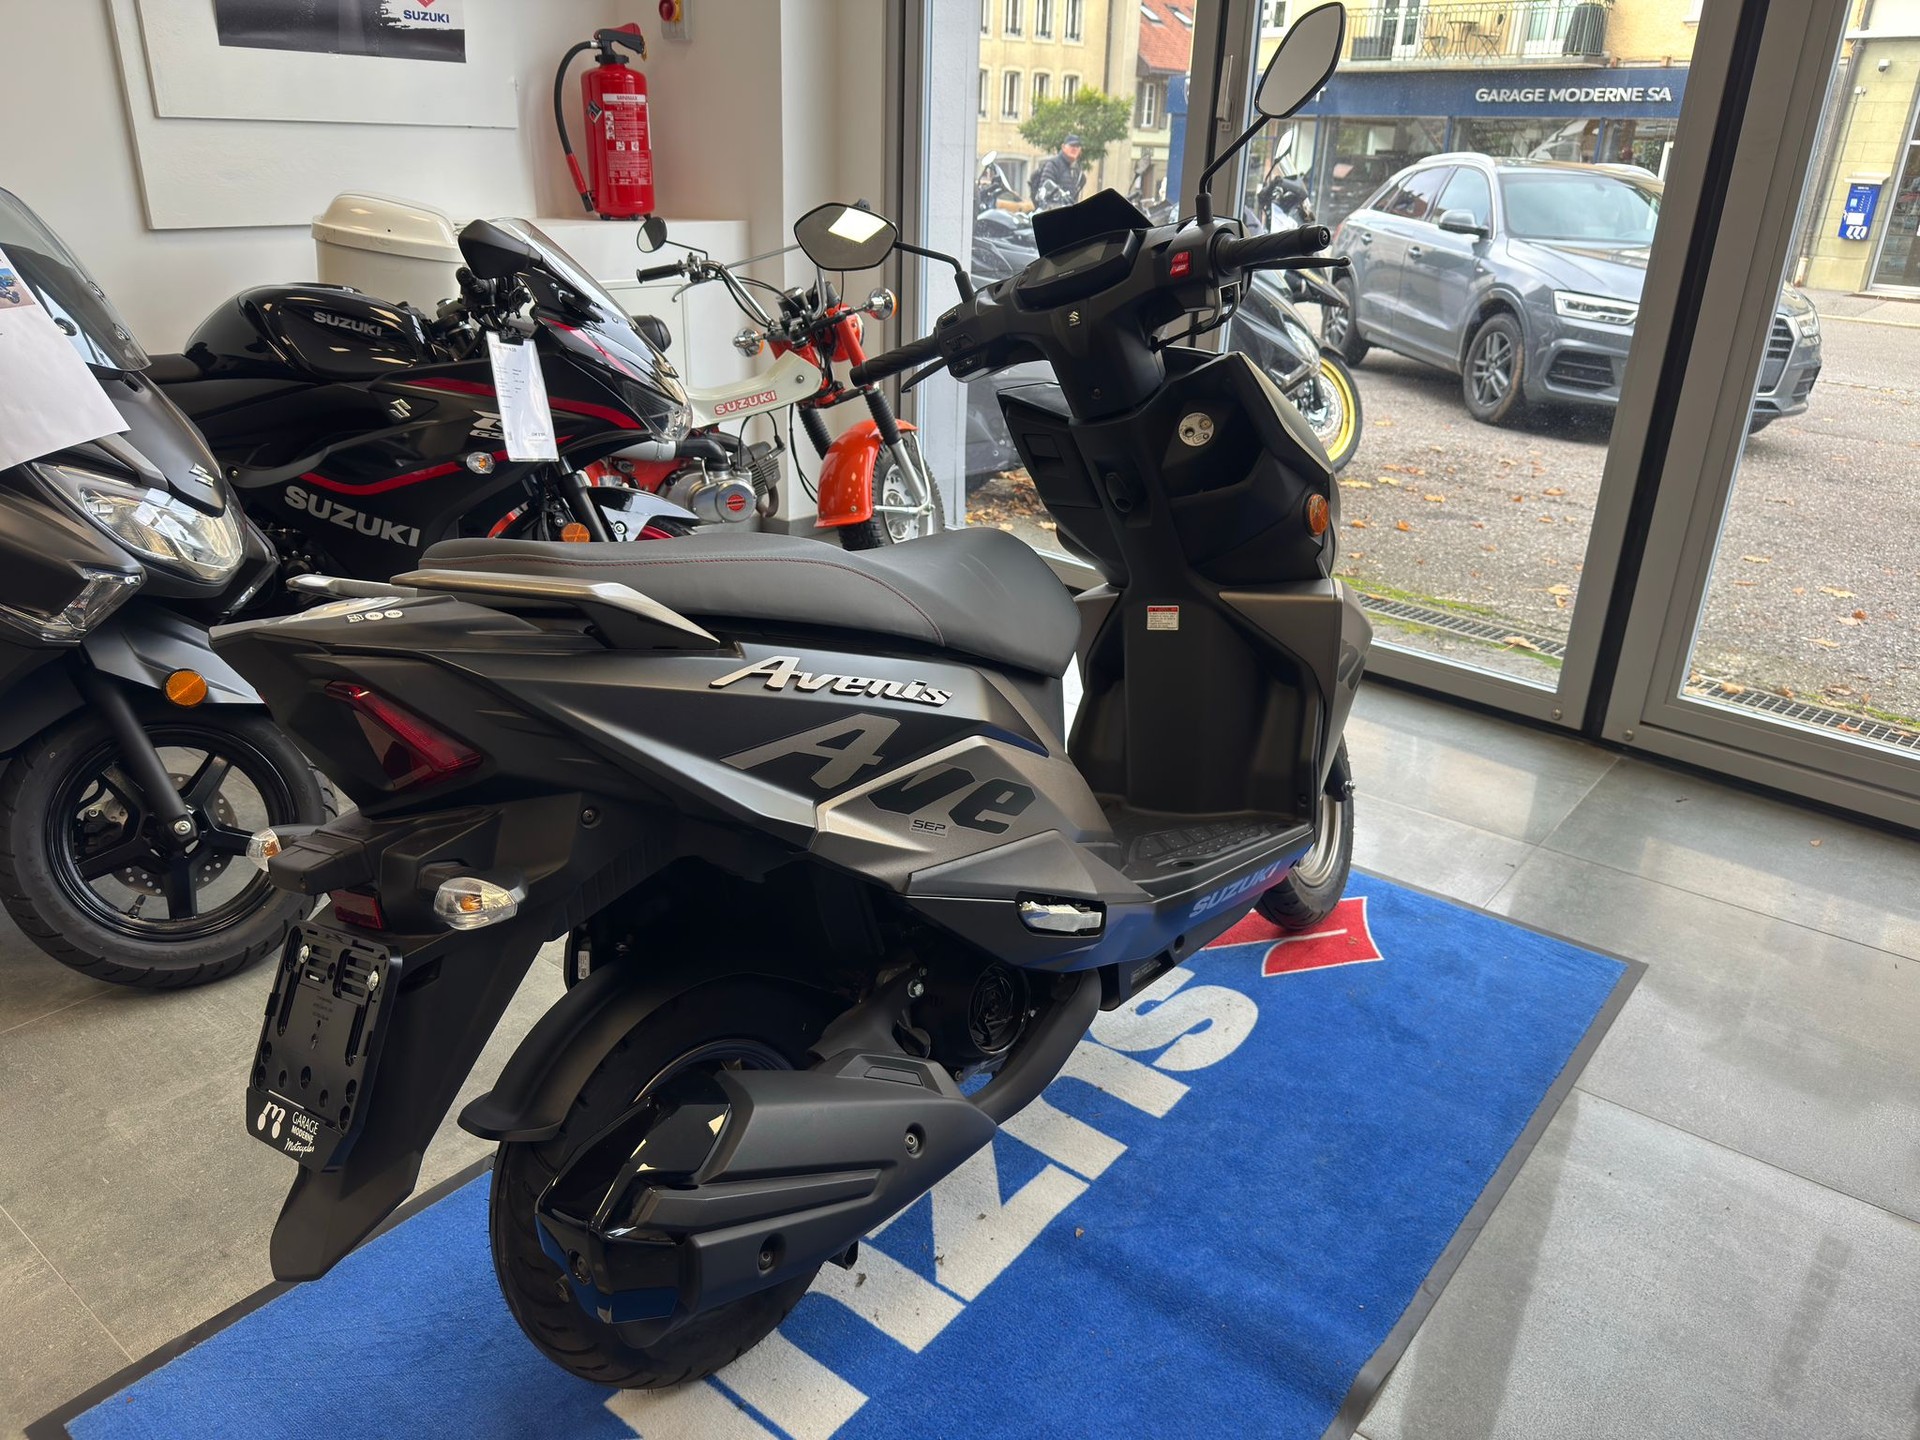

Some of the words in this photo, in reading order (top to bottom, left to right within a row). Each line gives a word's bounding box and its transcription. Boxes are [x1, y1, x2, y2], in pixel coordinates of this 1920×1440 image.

[403, 9, 450, 24] SUZUKI
[1475, 88, 1545, 103] GARAGE
[1549, 88, 1644, 103] MODERNE
[1646, 87, 1673, 102] SA
[313, 311, 383, 337] SUZUKI
[714, 389, 778, 416] SUZUKI
[284, 485, 421, 548] SUZUKI
[708, 655, 954, 706] Avenis
[912, 819, 947, 832] SEP
[1189, 860, 1281, 919] SUZUKI
[291, 1125, 314, 1141] MODERNE
[292, 1111, 319, 1135] GARAGE
[600, 966, 1259, 1440] SUZU
